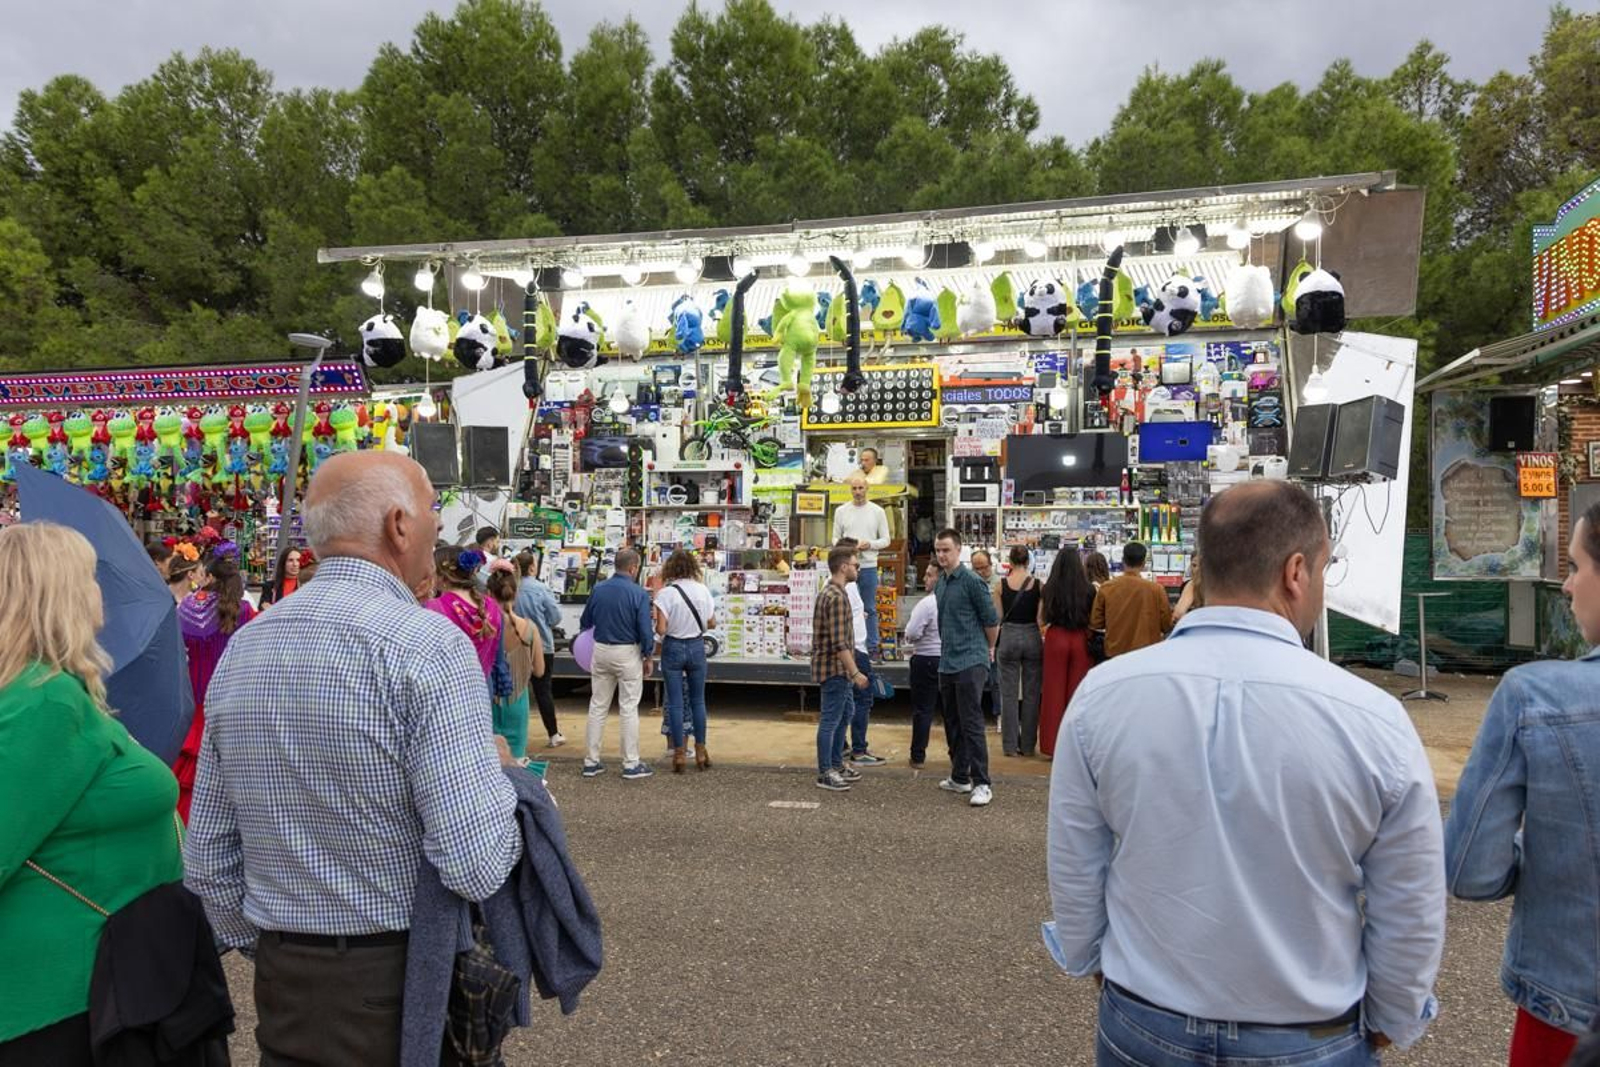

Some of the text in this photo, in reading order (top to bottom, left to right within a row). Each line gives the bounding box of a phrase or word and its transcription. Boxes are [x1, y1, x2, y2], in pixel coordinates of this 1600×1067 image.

[5, 371, 302, 398] DIVERTIJUEGOS
[985, 387, 1031, 400] TODOS
[1519, 454, 1555, 468] VINOS
[1523, 482, 1543, 493] 5.00
[1546, 482, 1553, 493] €
